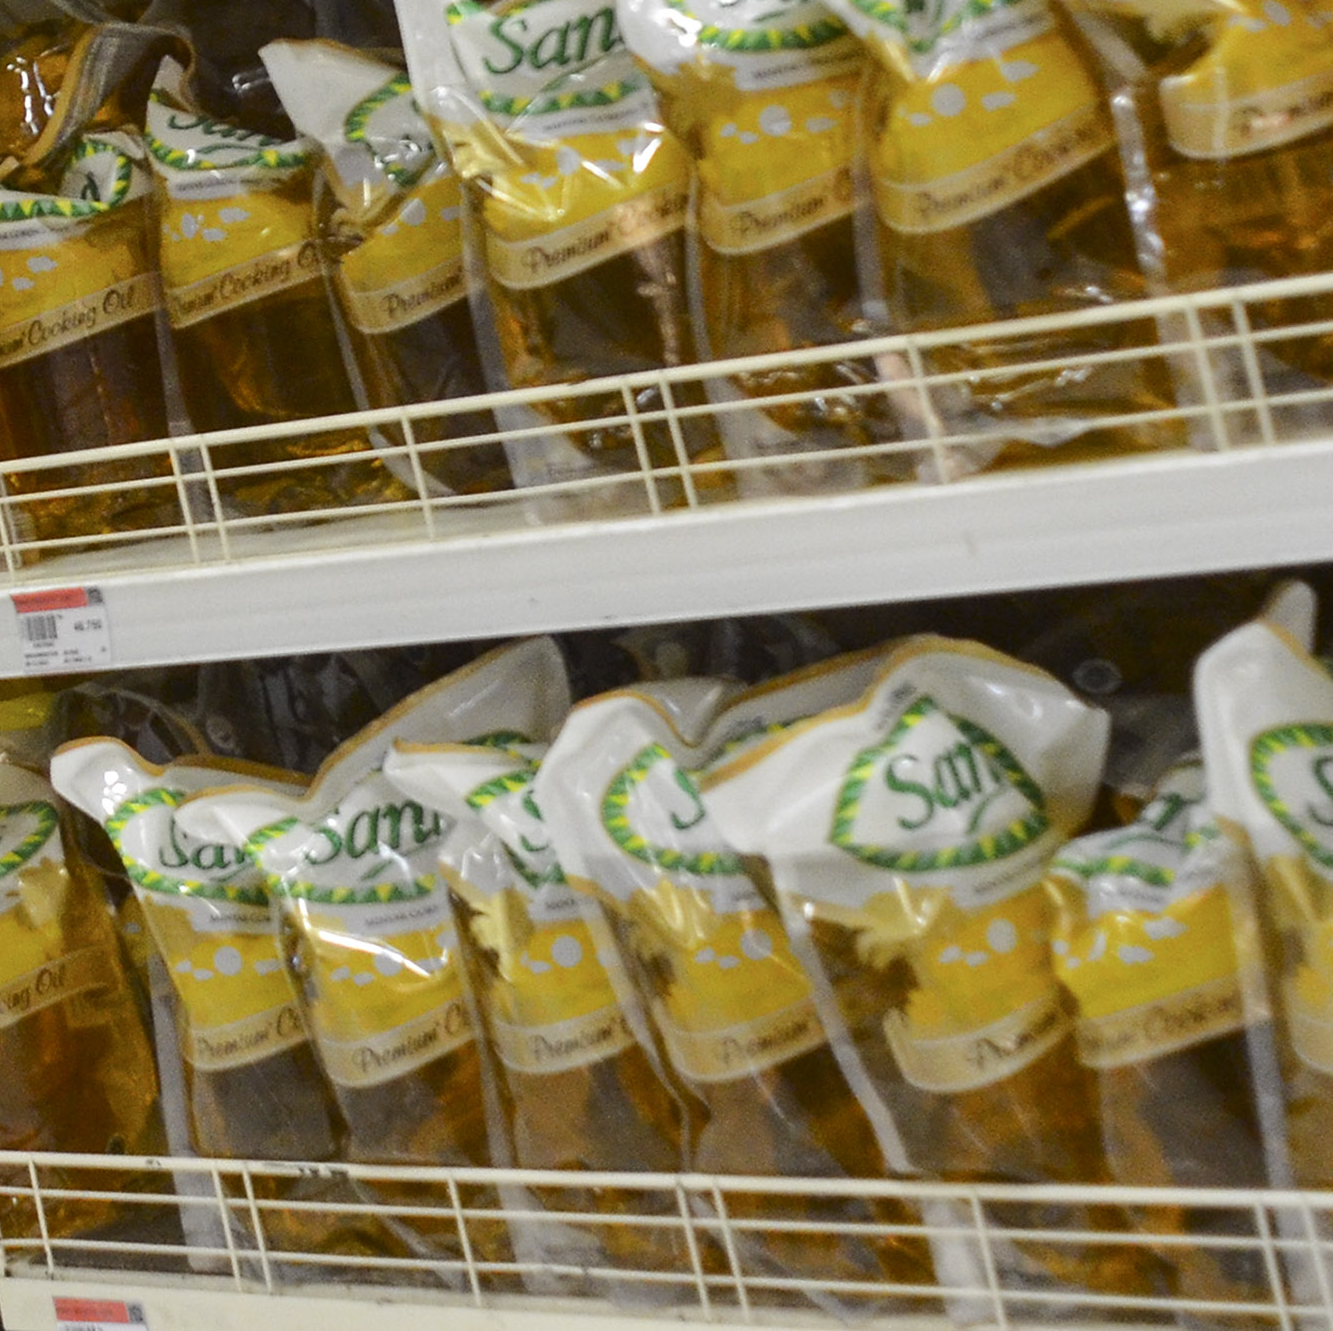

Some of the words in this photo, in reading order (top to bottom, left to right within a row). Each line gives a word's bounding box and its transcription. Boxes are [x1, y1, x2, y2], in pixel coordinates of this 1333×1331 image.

[520, 230, 611, 271] Premium
[219, 266, 290, 304] Cooking
[28, 303, 97, 348] Cooking
[102, 284, 137, 315] Oil
